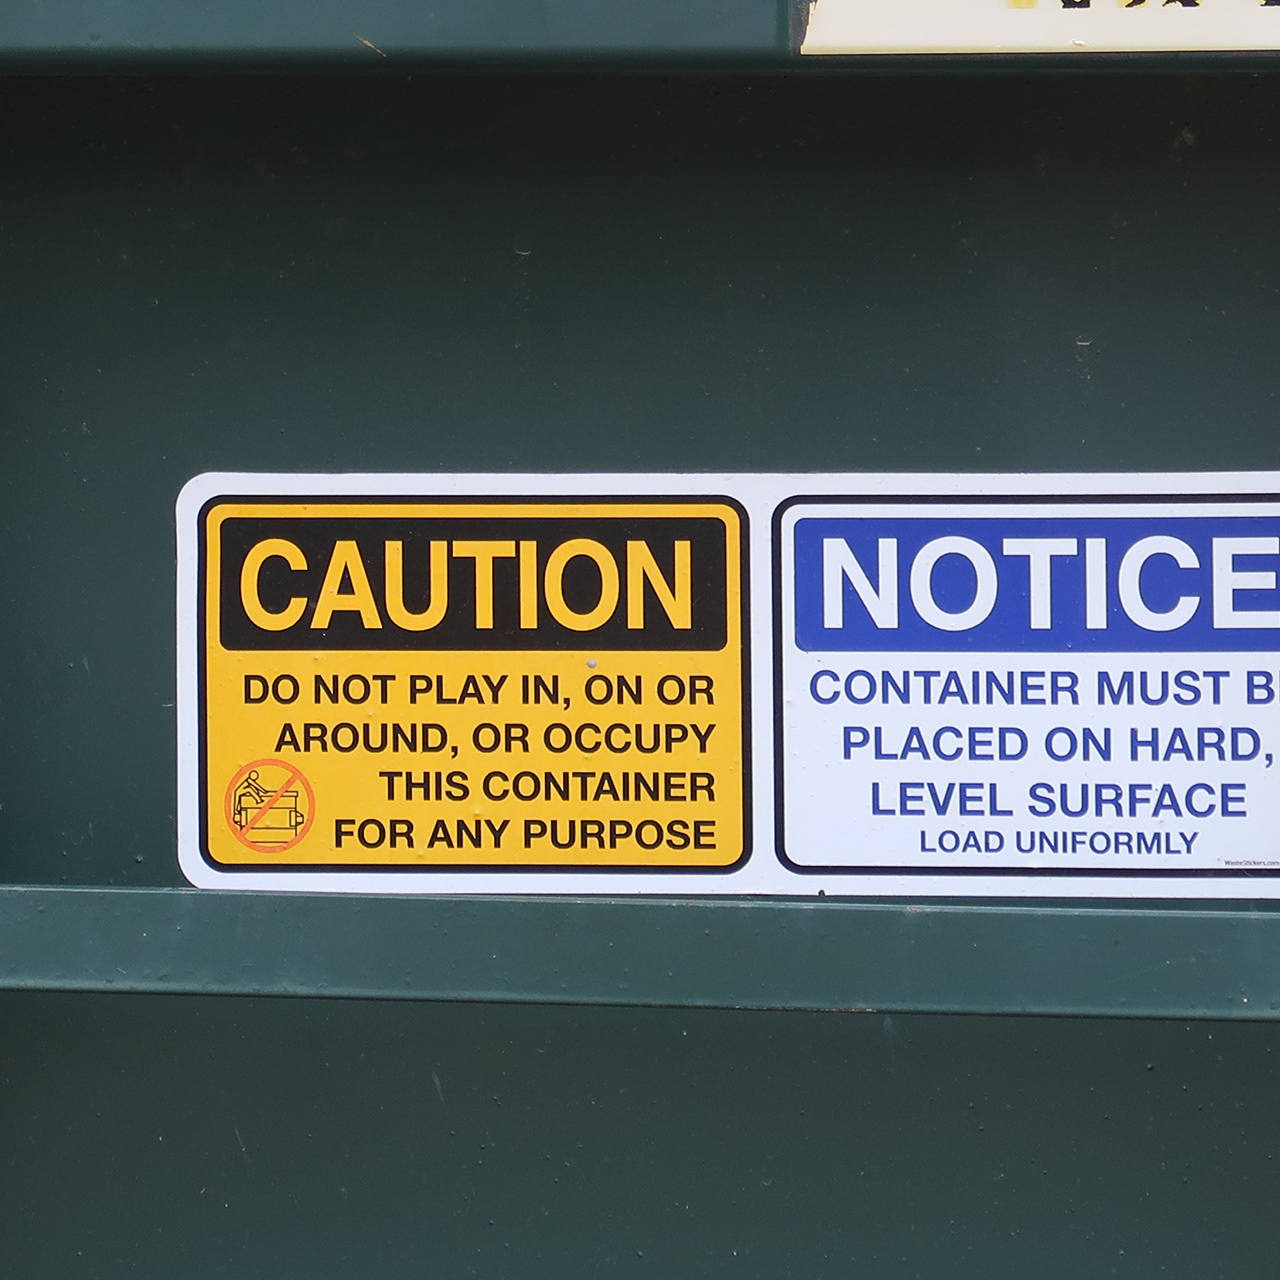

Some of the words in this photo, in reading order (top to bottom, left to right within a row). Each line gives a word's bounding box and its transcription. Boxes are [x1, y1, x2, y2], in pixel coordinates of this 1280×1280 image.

[241, 539, 691, 631] CAUTION
[245, 675, 299, 704] DO
[315, 675, 395, 704] NOT
[410, 675, 507, 704] PLAY
[523, 675, 570, 710] IN,
[585, 675, 641, 704] ON
[657, 675, 713, 705] OR
[810, 670, 1078, 704] CONTAINER
[1098, 671, 1230, 705] MUST
[275, 723, 457, 758] AROUND,
[473, 723, 528, 752] OR
[544, 723, 715, 753] OCCUPY
[844, 727, 1028, 760] PLACED
[1045, 727, 1111, 761] ON
[1131, 728, 1272, 768] HARD,
[379, 771, 469, 801] THIS
[483, 771, 714, 801] CONTAINER
[872, 783, 1013, 816] LEVEL
[1029, 783, 1246, 817] SURFACE
[336, 819, 413, 848] FOR
[428, 820, 509, 848] ANY
[525, 820, 716, 849] PURPOSE
[921, 831, 1004, 852] LOAD
[1016, 831, 1198, 854] UNIFORMLY
